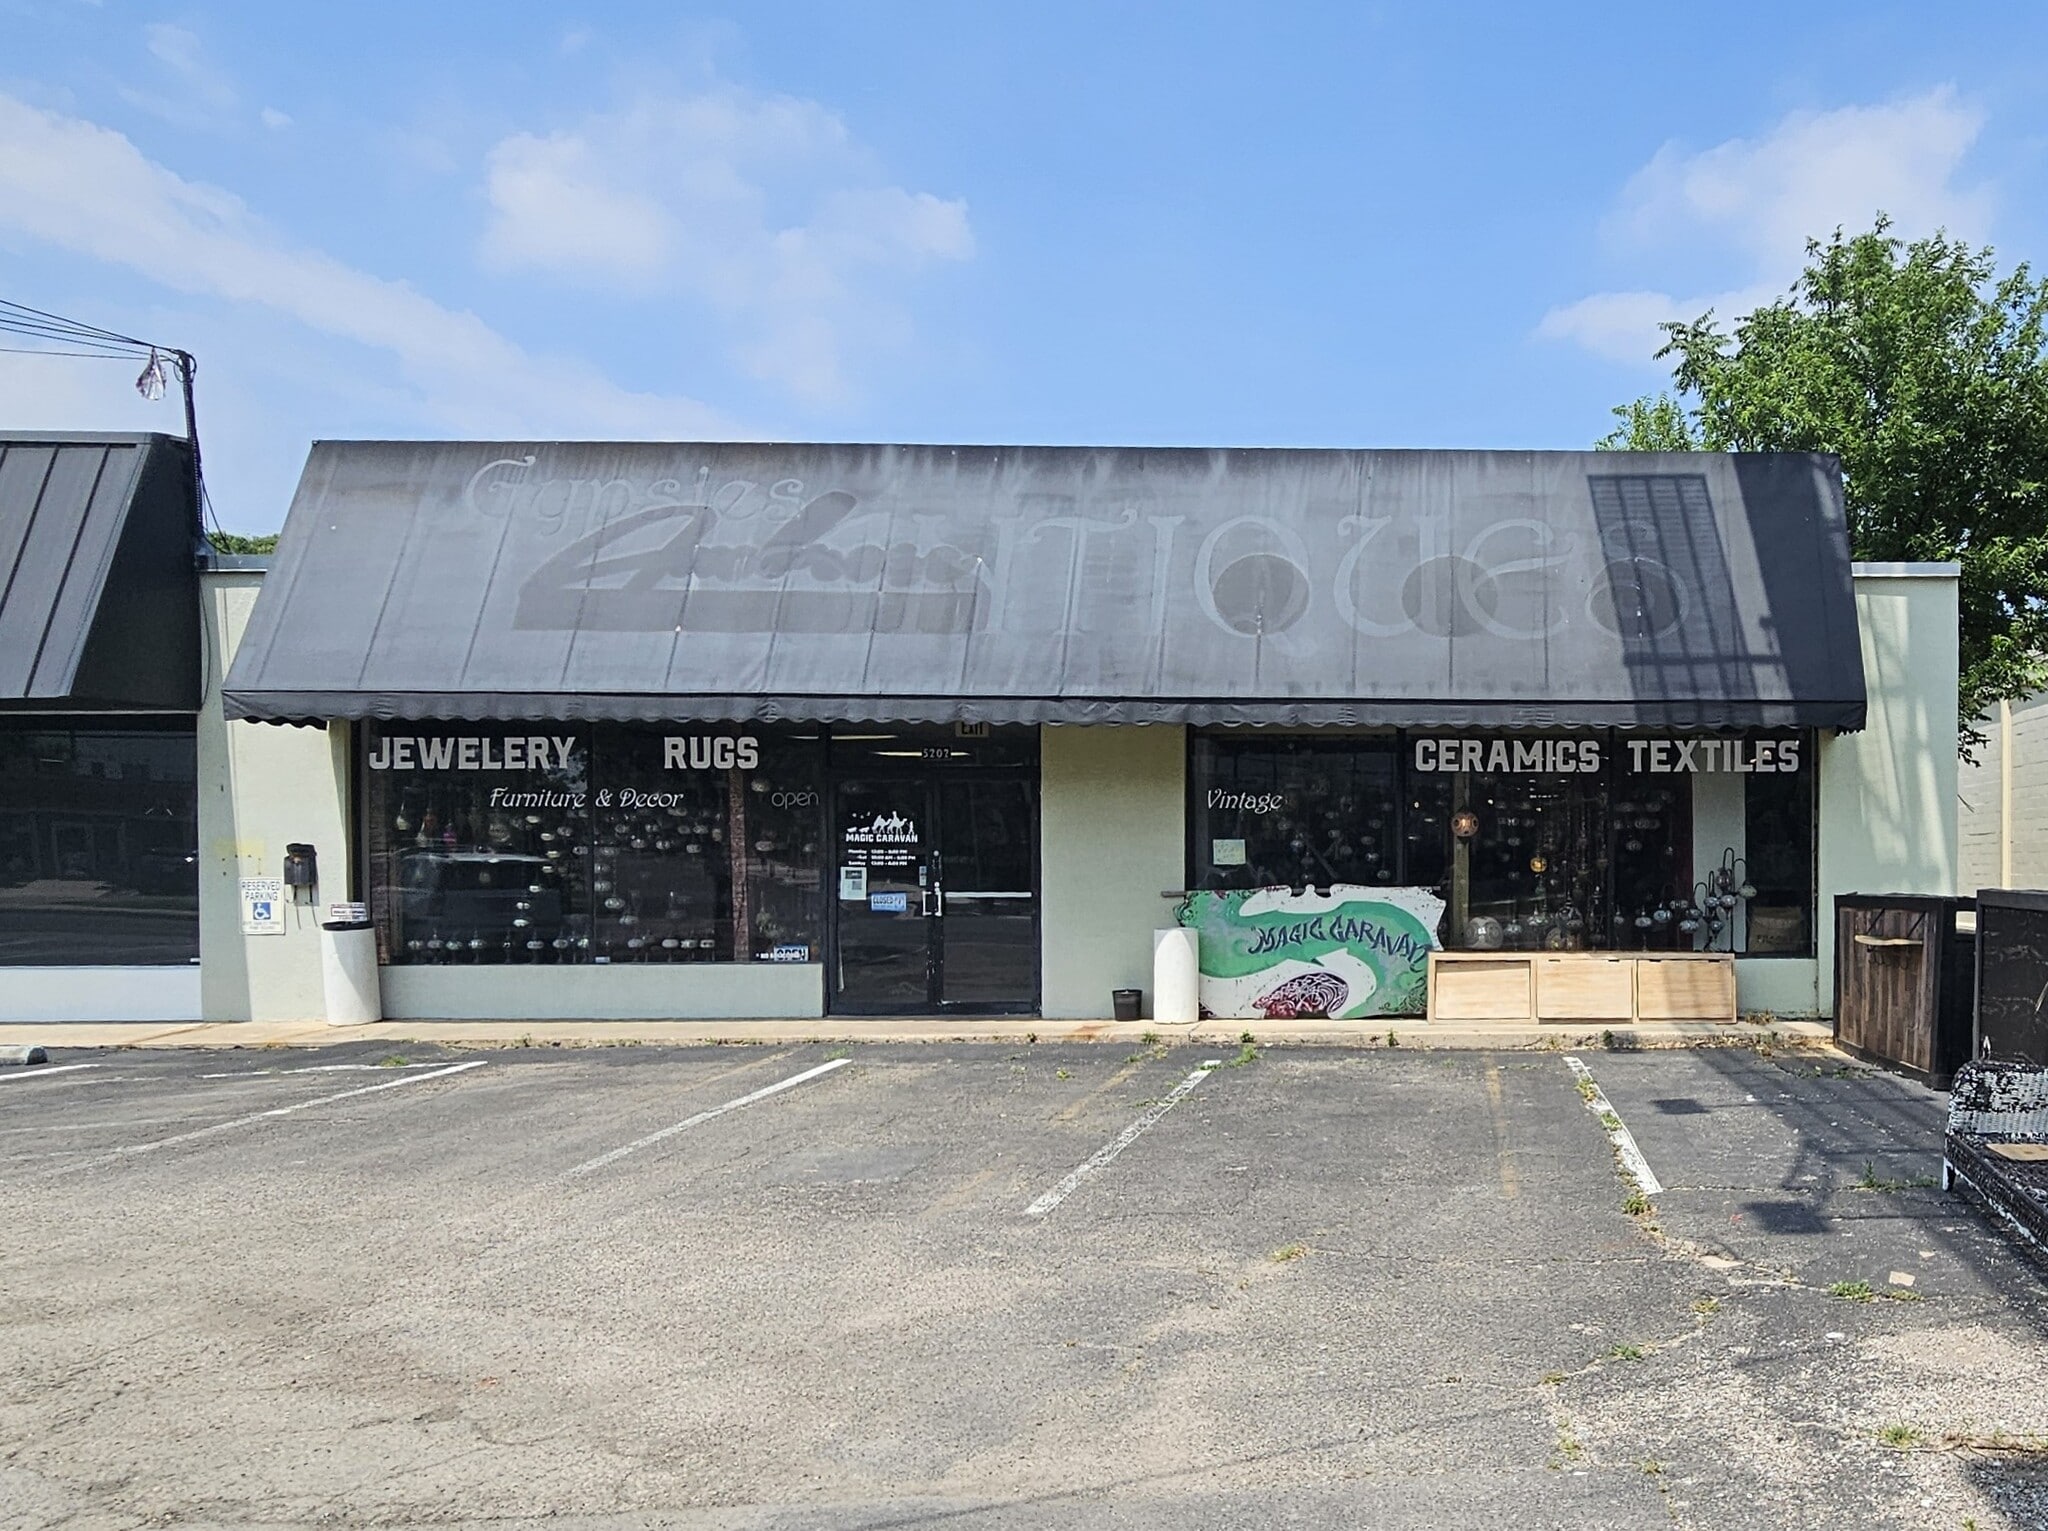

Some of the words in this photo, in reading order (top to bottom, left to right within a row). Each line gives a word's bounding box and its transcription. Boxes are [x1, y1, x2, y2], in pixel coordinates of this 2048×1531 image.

[369, 736, 576, 770] JEWELERY
[664, 736, 759, 769] RUGS
[1415, 739, 1600, 773] CERAMICS
[1627, 739, 1800, 773] TEXTILES
[489, 787, 587, 810] Furniture
[595, 788, 612, 807] &
[619, 787, 684, 810] Decor
[1207, 788, 1283, 815] Vintage
[845, 833, 874, 843] MAGIC
[876, 833, 919, 843] CARAVAN
[241, 881, 280, 891] RESERVED
[245, 891, 278, 901] PARKING
